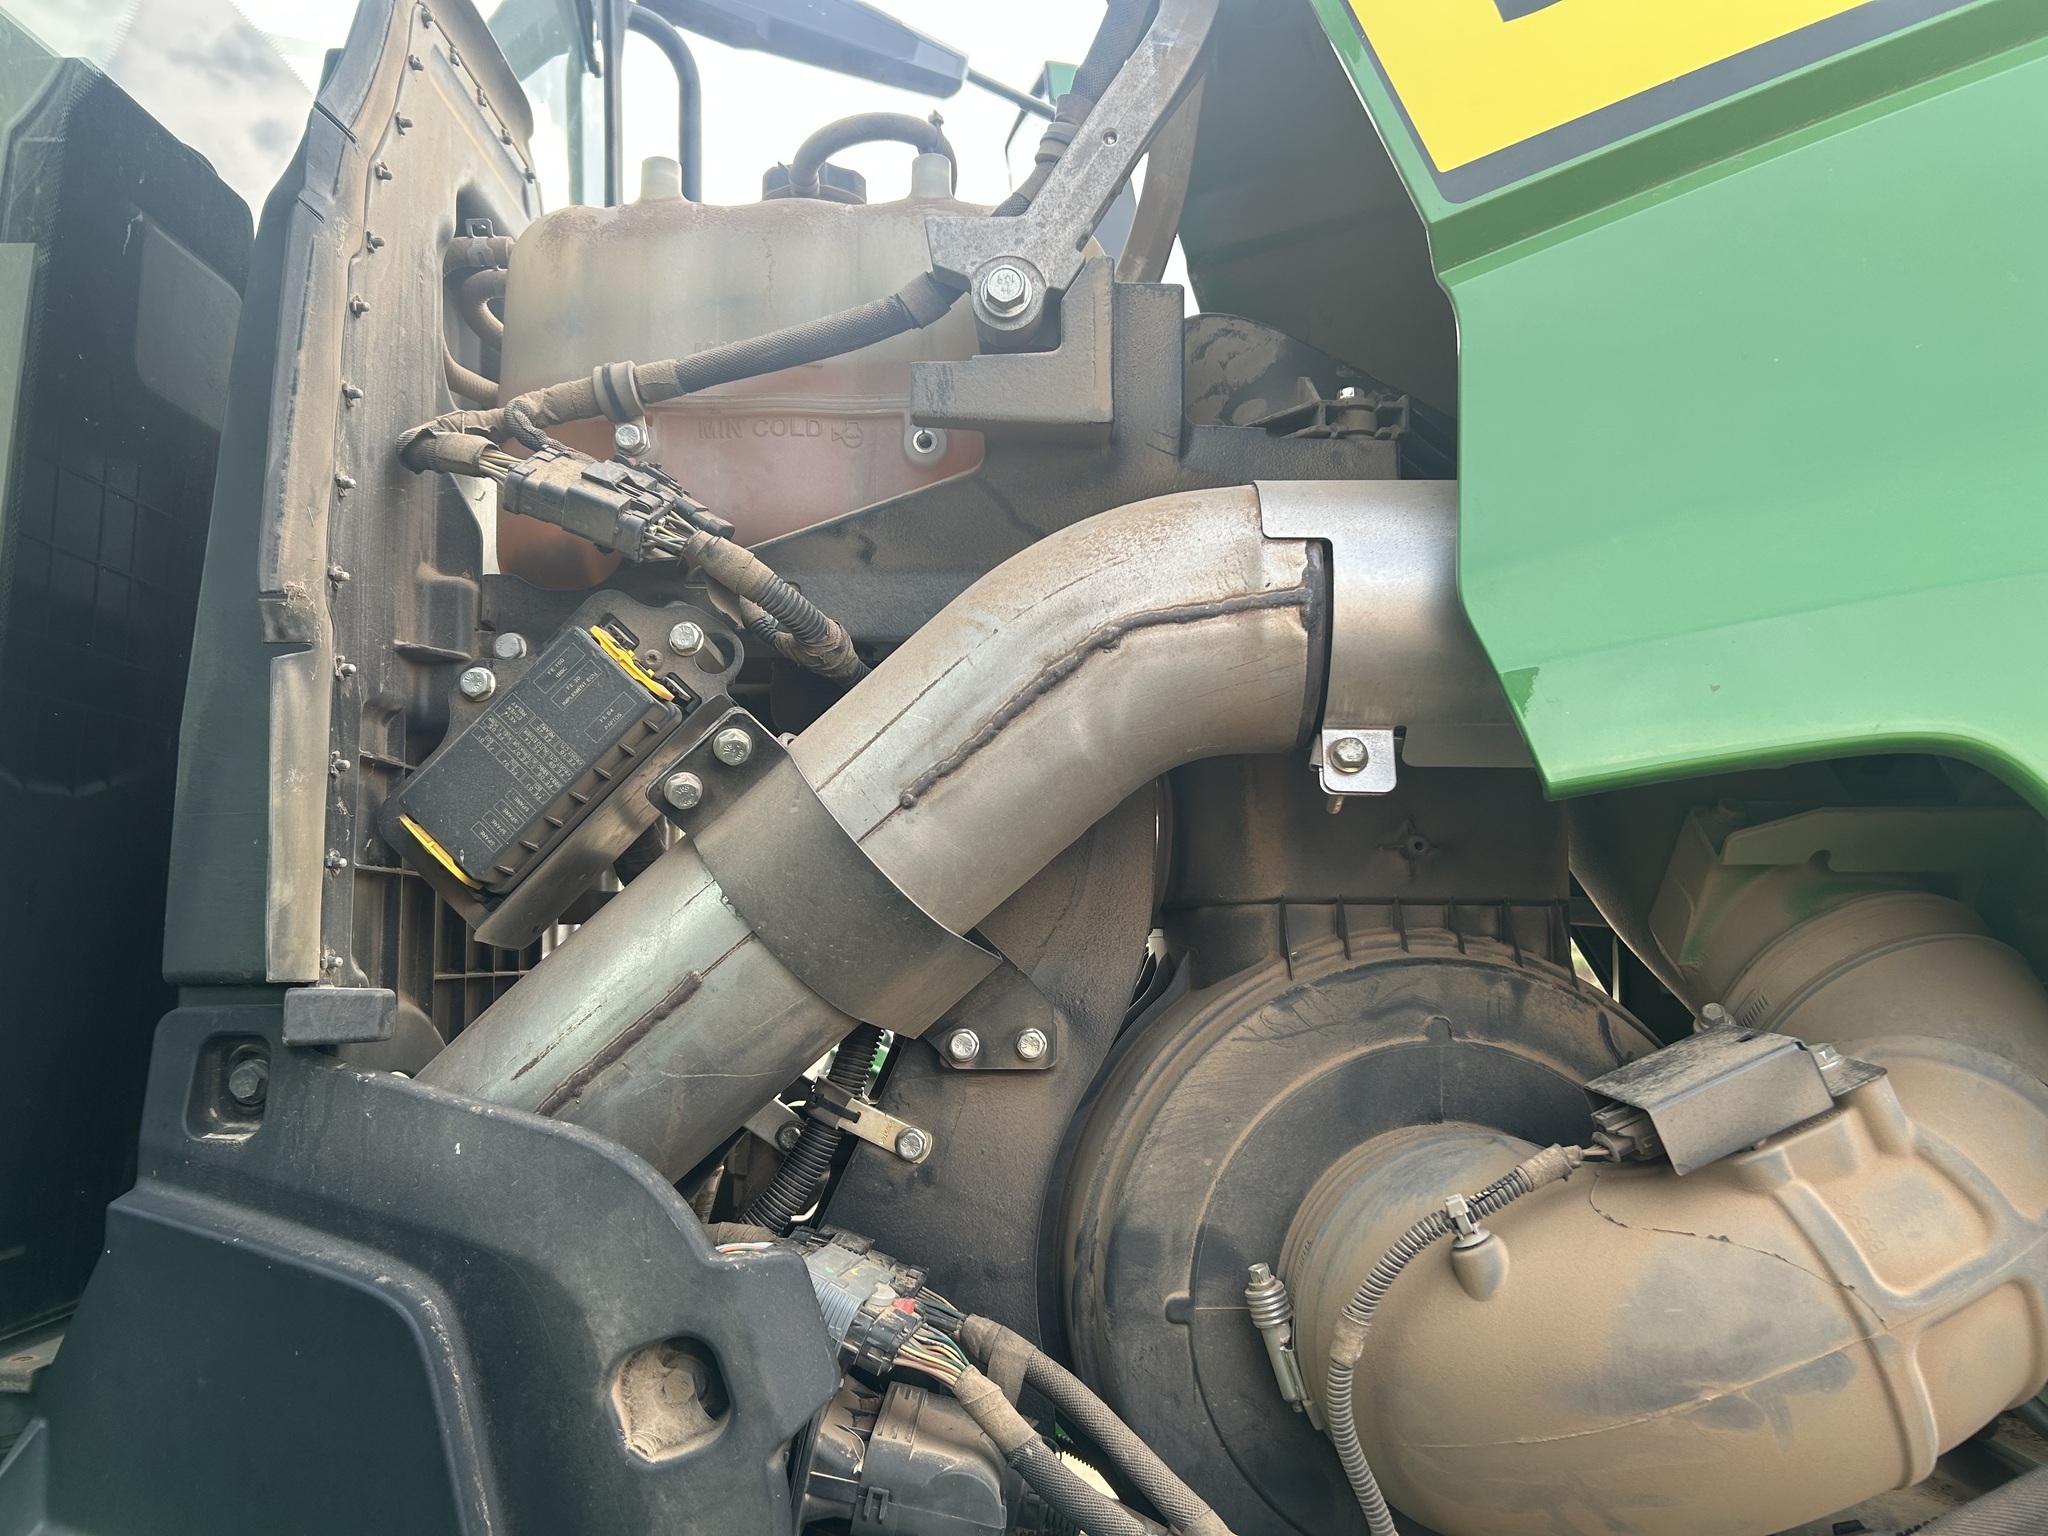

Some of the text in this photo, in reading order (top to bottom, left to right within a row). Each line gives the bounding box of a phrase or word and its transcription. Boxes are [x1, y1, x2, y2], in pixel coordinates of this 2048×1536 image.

[699, 419, 823, 439] MIN COLD
[554, 657, 565, 668] 100
[561, 671, 597, 706] IMPLEMENT ECU
[506, 705, 522, 720] ETHER
[510, 700, 527, 716] RELAY
[567, 750, 583, 765] FRONT
[556, 761, 571, 776] FRONT
[513, 795, 530, 812] SPARE
[502, 807, 519, 824] SPARE
[490, 818, 507, 835] SPARE
[478, 828, 496, 846] SPARE
